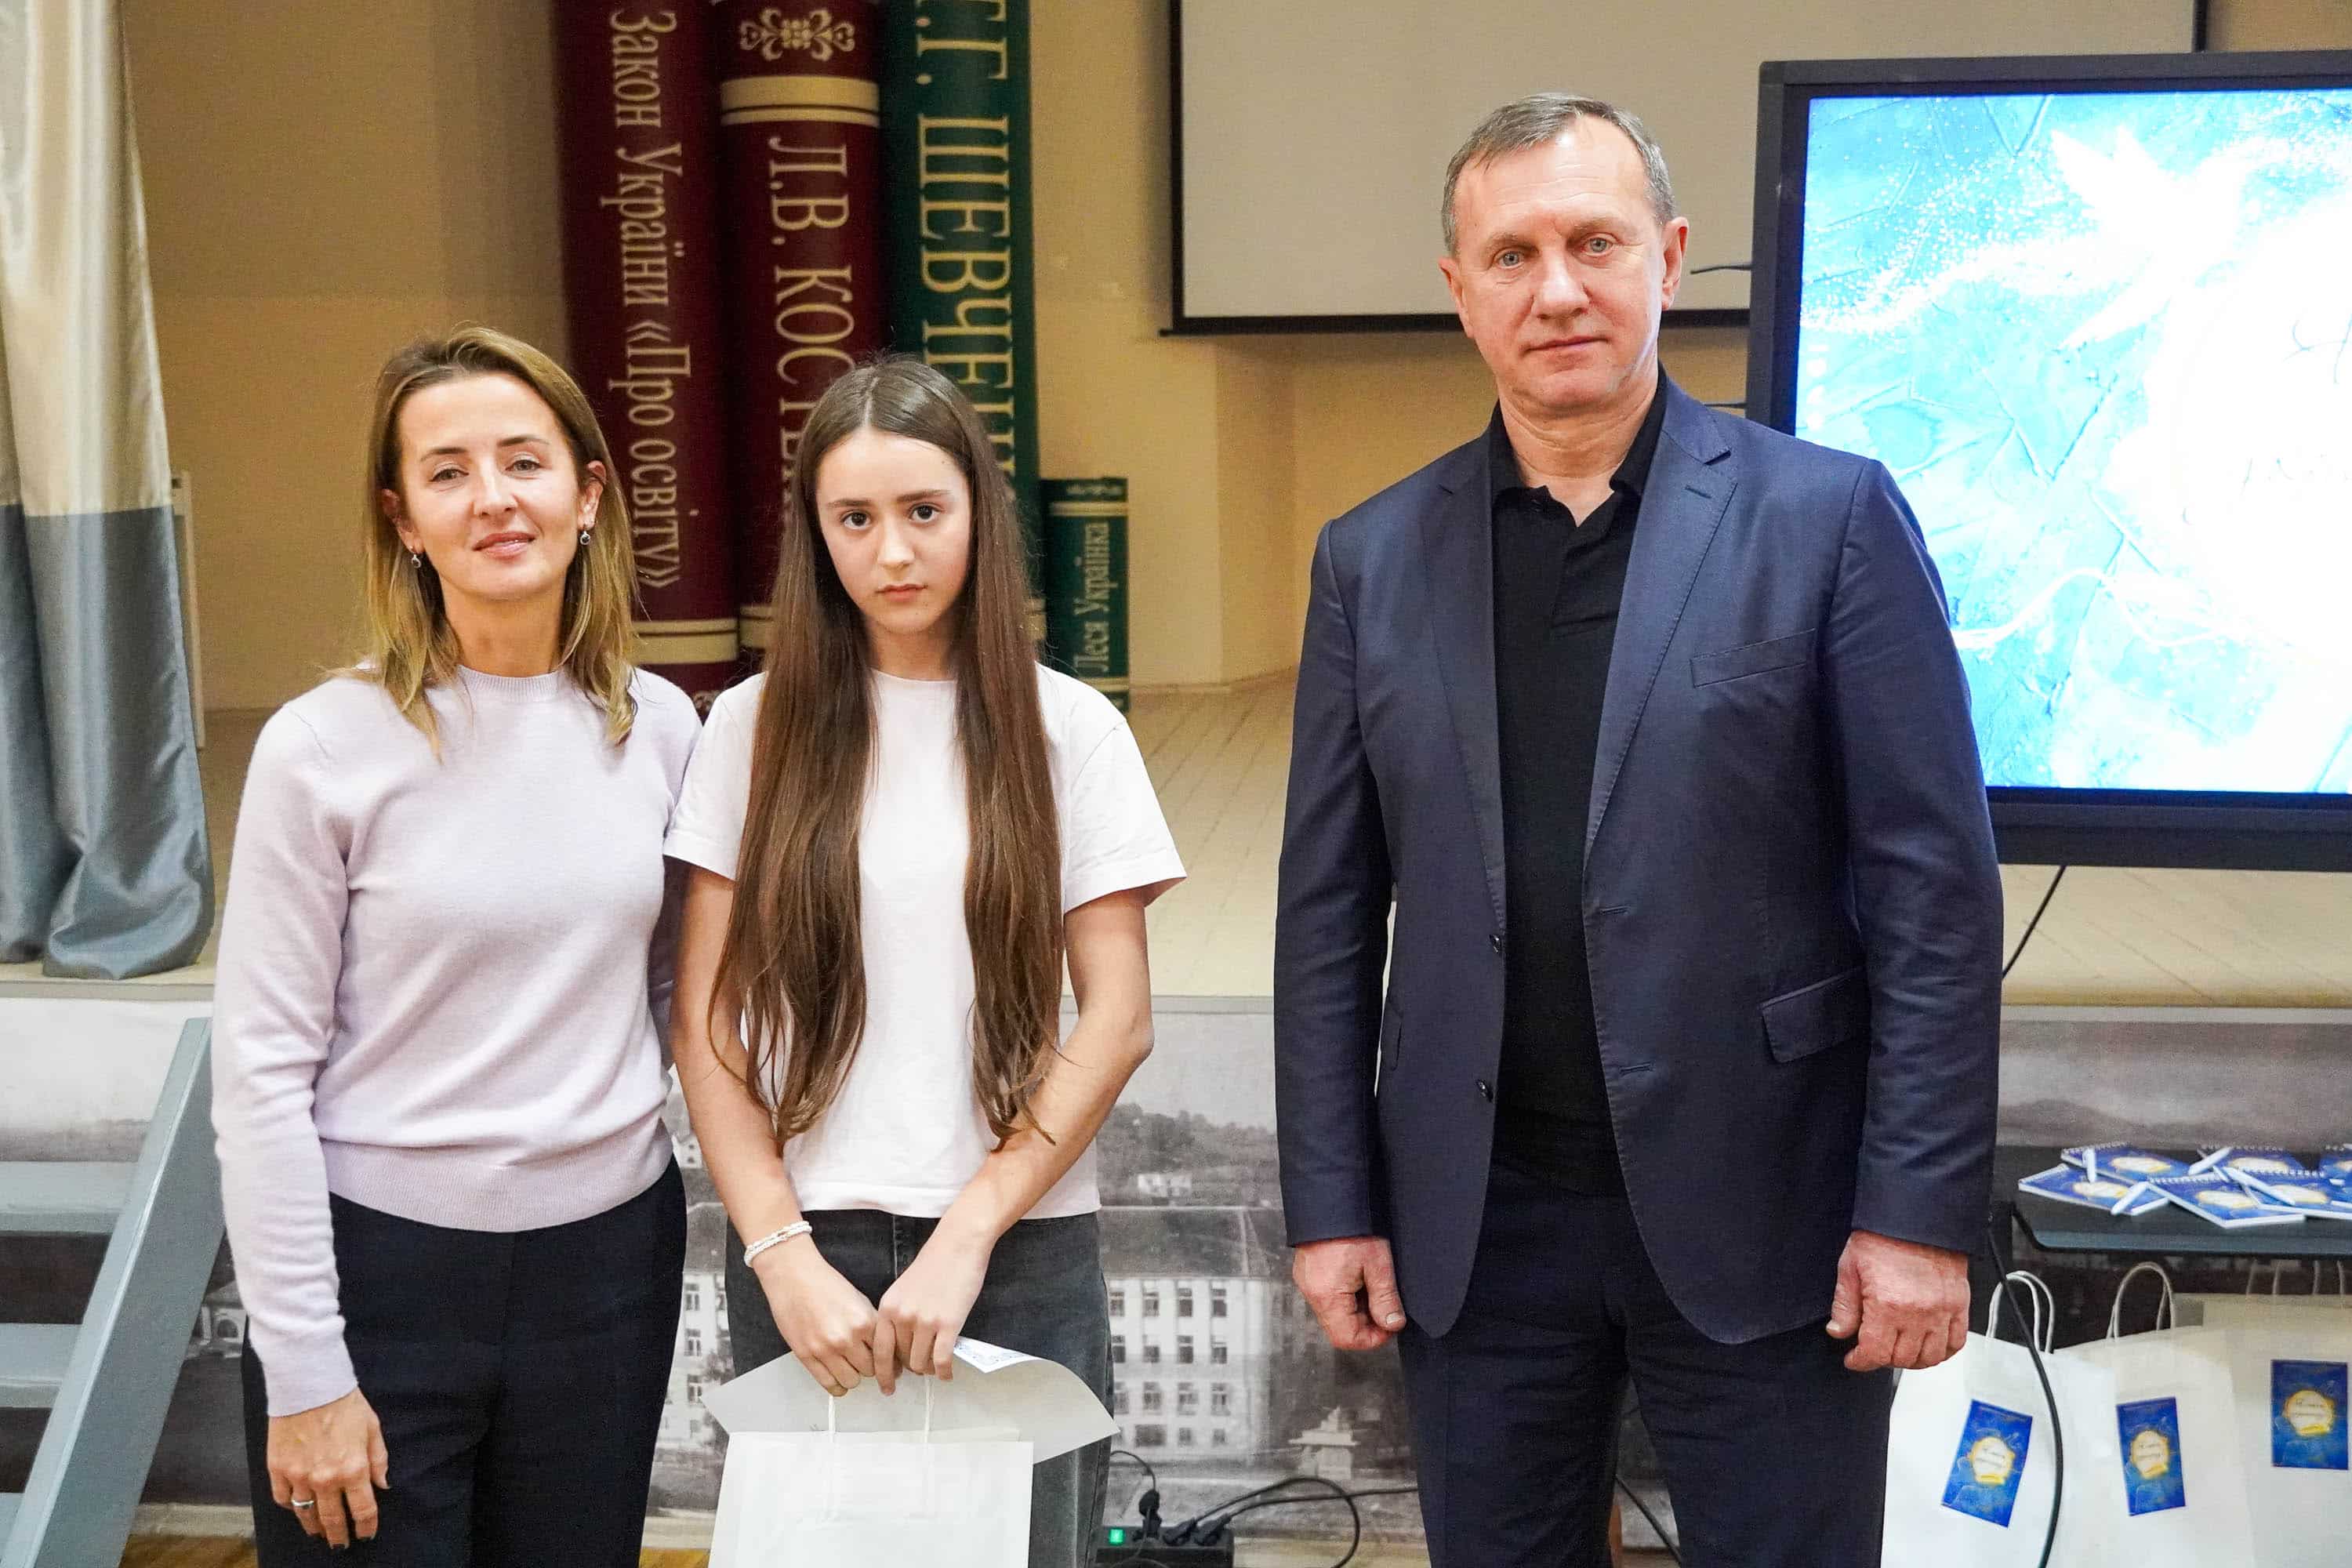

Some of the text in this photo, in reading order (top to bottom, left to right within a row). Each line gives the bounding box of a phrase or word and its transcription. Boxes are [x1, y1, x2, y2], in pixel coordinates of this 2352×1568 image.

[600, 9, 699, 589] Закон України «Про освіту»
[769, 136, 849, 246] Л.В.
[918, 114, 1014, 477] ШЕВЧЕ
[1073, 521, 1119, 673] Леся Українка
